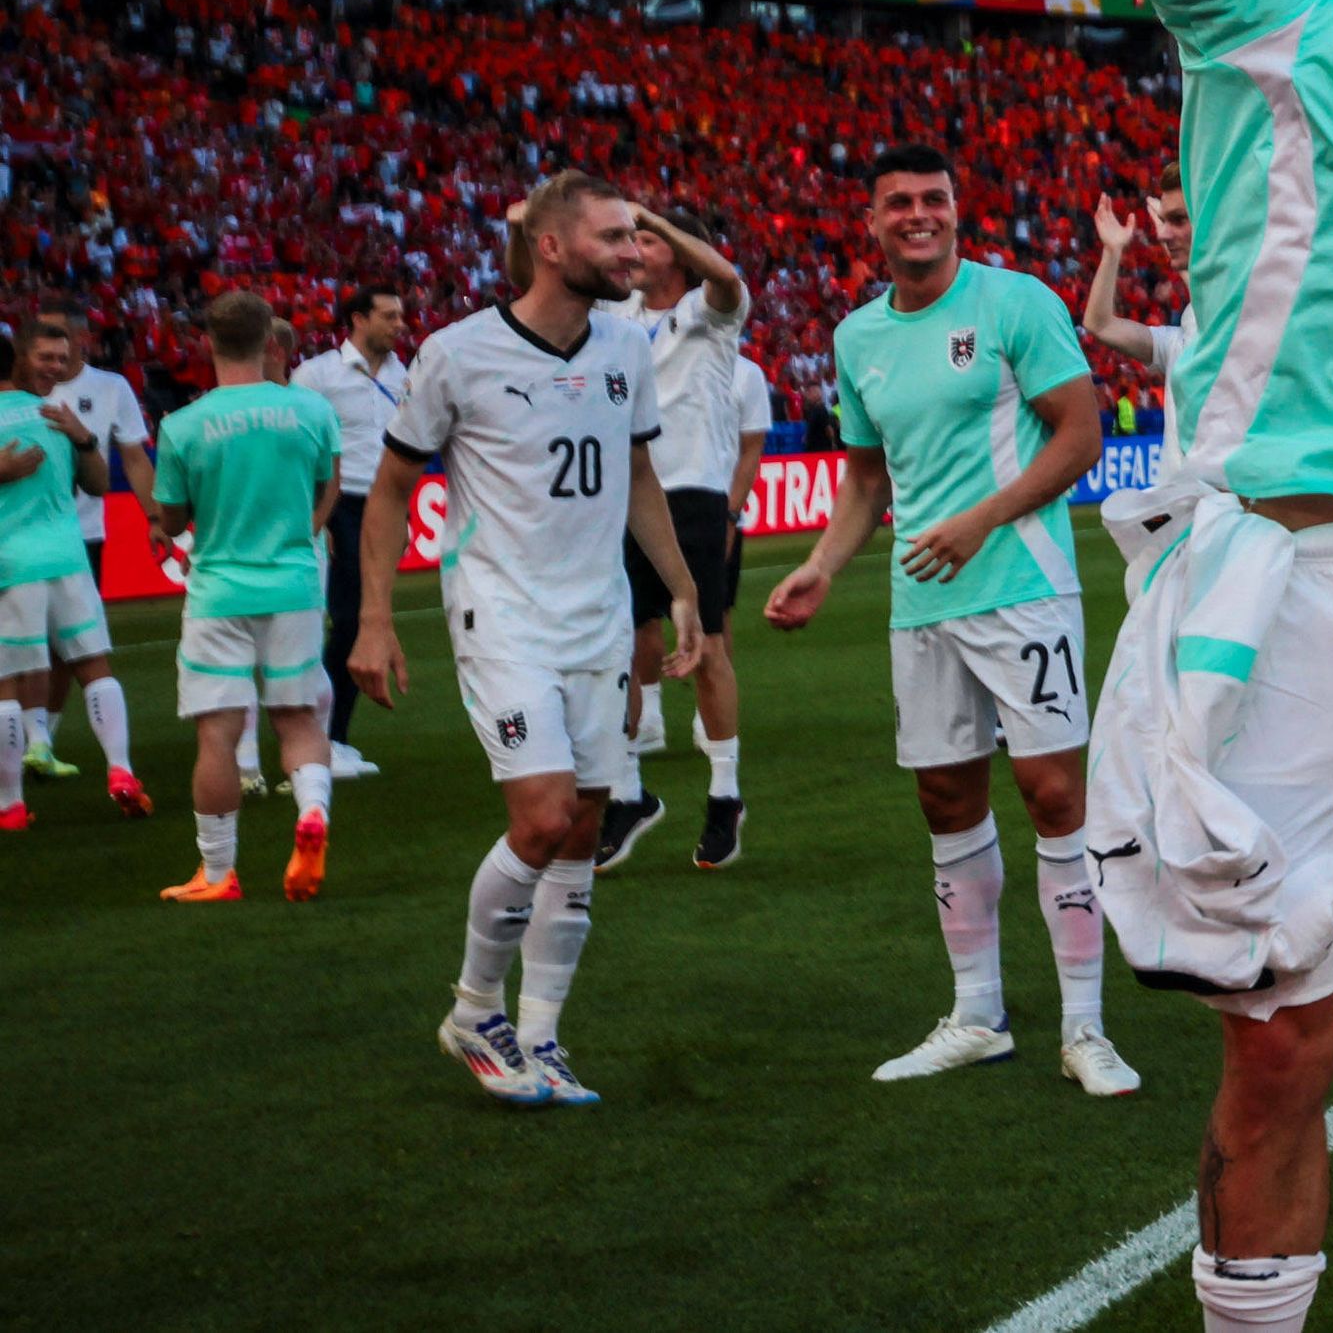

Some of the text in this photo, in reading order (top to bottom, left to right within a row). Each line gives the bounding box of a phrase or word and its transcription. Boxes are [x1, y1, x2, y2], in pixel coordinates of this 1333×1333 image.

[202, 406, 299, 443] AUSTRIA
[548, 434, 602, 497] 20
[1086, 444, 1146, 492] UEFA
[1020, 633, 1079, 705] 21
